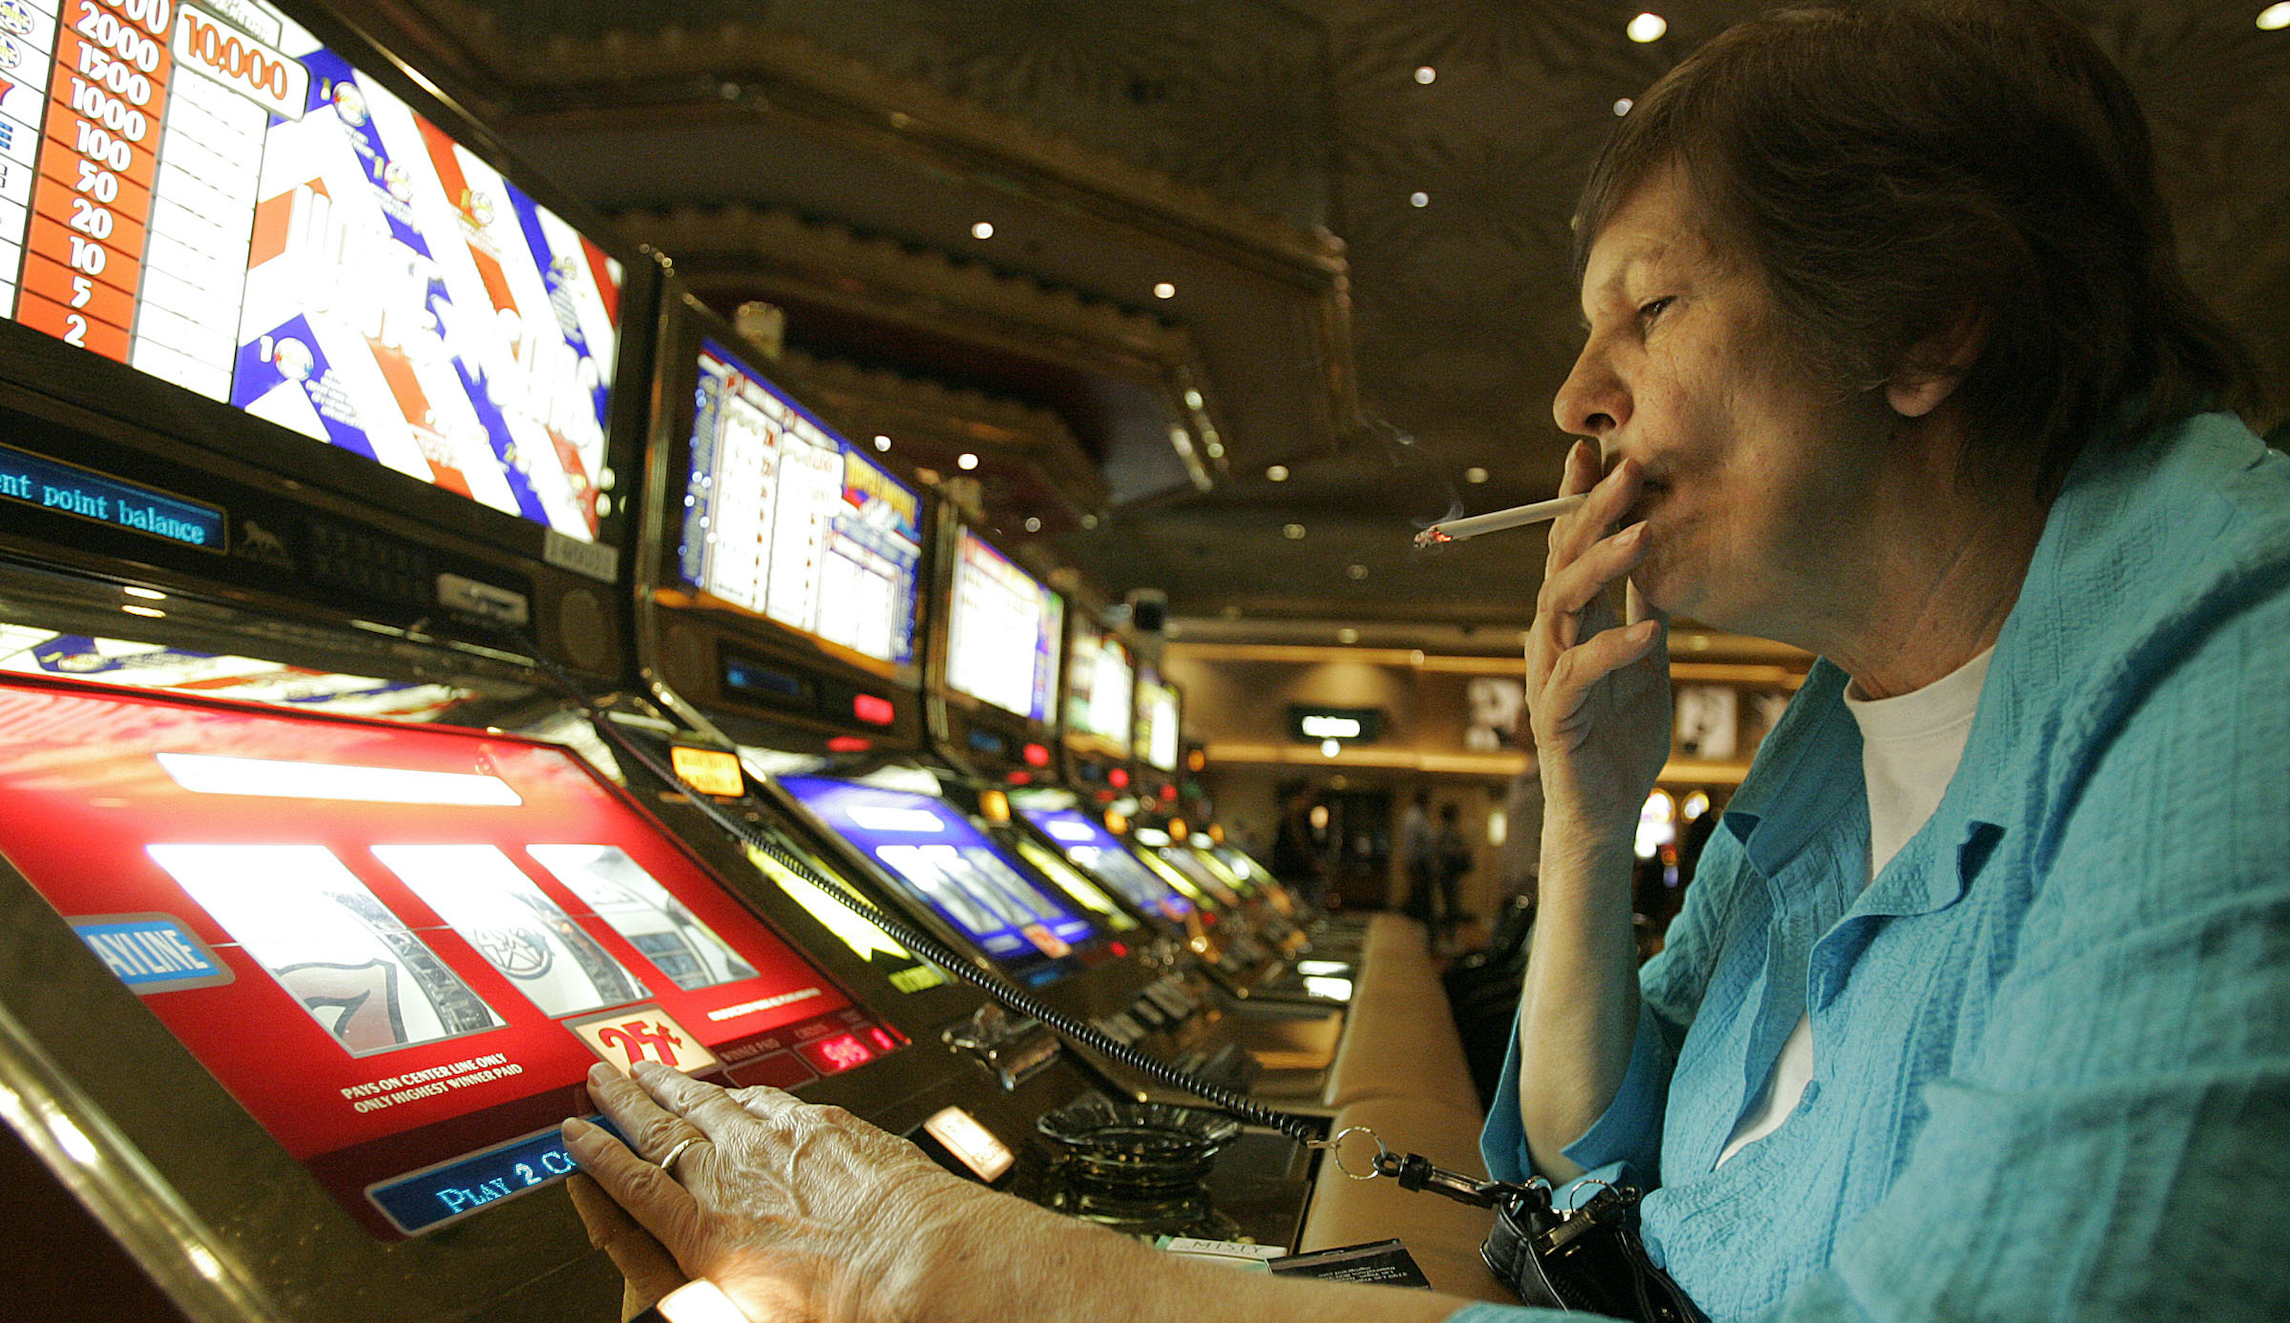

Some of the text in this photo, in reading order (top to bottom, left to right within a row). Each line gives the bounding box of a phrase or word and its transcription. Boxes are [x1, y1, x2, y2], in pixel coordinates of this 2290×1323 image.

[76, 0, 160, 73] 2000
[77, 40, 152, 106] 1500
[71, 76, 147, 142] 1000
[76, 119, 132, 172] 100
[77, 159, 119, 204] 50
[70, 197, 114, 240] 20
[69, 235, 107, 276] 10
[70, 275, 93, 309] 5
[63, 313, 88, 348] 2
[0, 474, 206, 545] nt point balance
[340, 1052, 509, 1100] PAYS ON CENTER LINE ONLY
[353, 1062, 525, 1114] ONLY HIGHEST WINNER PAID
[514, 1162, 543, 1187] 2
